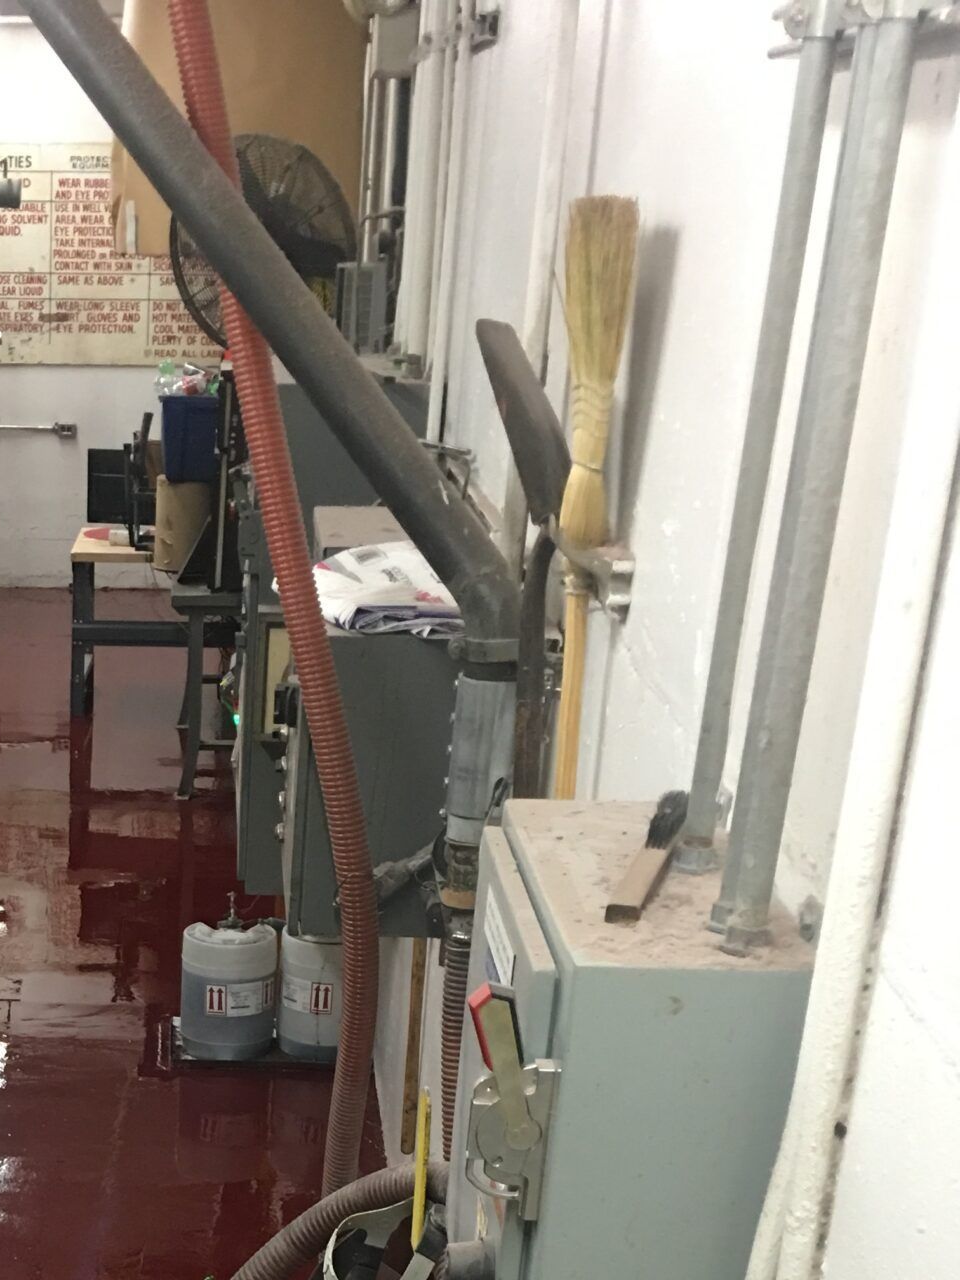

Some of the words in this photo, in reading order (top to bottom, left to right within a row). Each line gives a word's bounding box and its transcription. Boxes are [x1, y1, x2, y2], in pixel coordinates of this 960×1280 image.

[58, 178, 81, 188] WEAR
[84, 178, 109, 188] RUBBE
[55, 190, 72, 200] AND
[75, 190, 90, 200] EYE
[93, 190, 109, 200] PRO
[55, 203, 68, 213] USE
[72, 203, 80, 213] IN
[82, 203, 101, 213] WELL
[11, 214, 49, 225] SOLVENT
[80, 214, 105, 225] WEAR
[54, 226, 71, 236] EYE
[73, 226, 114, 236] PROTECTIO
[55, 238, 75, 248] TAKE
[53, 249, 96, 260] PROLONGED
[54, 261, 89, 271] CONTACT
[93, 261, 112, 271] WITH
[115, 262, 133, 272] SKIN
[13, 274, 48, 285] CLEANING
[57, 275, 80, 286] SAME
[84, 275, 94, 286] AS
[97, 275, 124, 286] ABOVE
[20, 286, 44, 296] LIQUID
[17, 300, 45, 311] FUMES
[83, 301, 105, 311] LONG
[109, 301, 141, 311] SLEEVE
[153, 302, 163, 311] DO
[166, 302, 182, 311] NOT
[14, 312, 34, 322] EYES
[87, 312, 118, 323] GLOVES
[122, 312, 141, 323] AND
[152, 313, 168, 322] HOT
[171, 313, 194, 323] MATE
[56, 323, 73, 334] EYE
[154, 324, 174, 334] COOL
[178, 324, 201, 334] MATE
[152, 335, 182, 345] PLENTY
[187, 335, 197, 345] OF
[154, 349, 177, 358] READ
[181, 349, 197, 358] ALL
